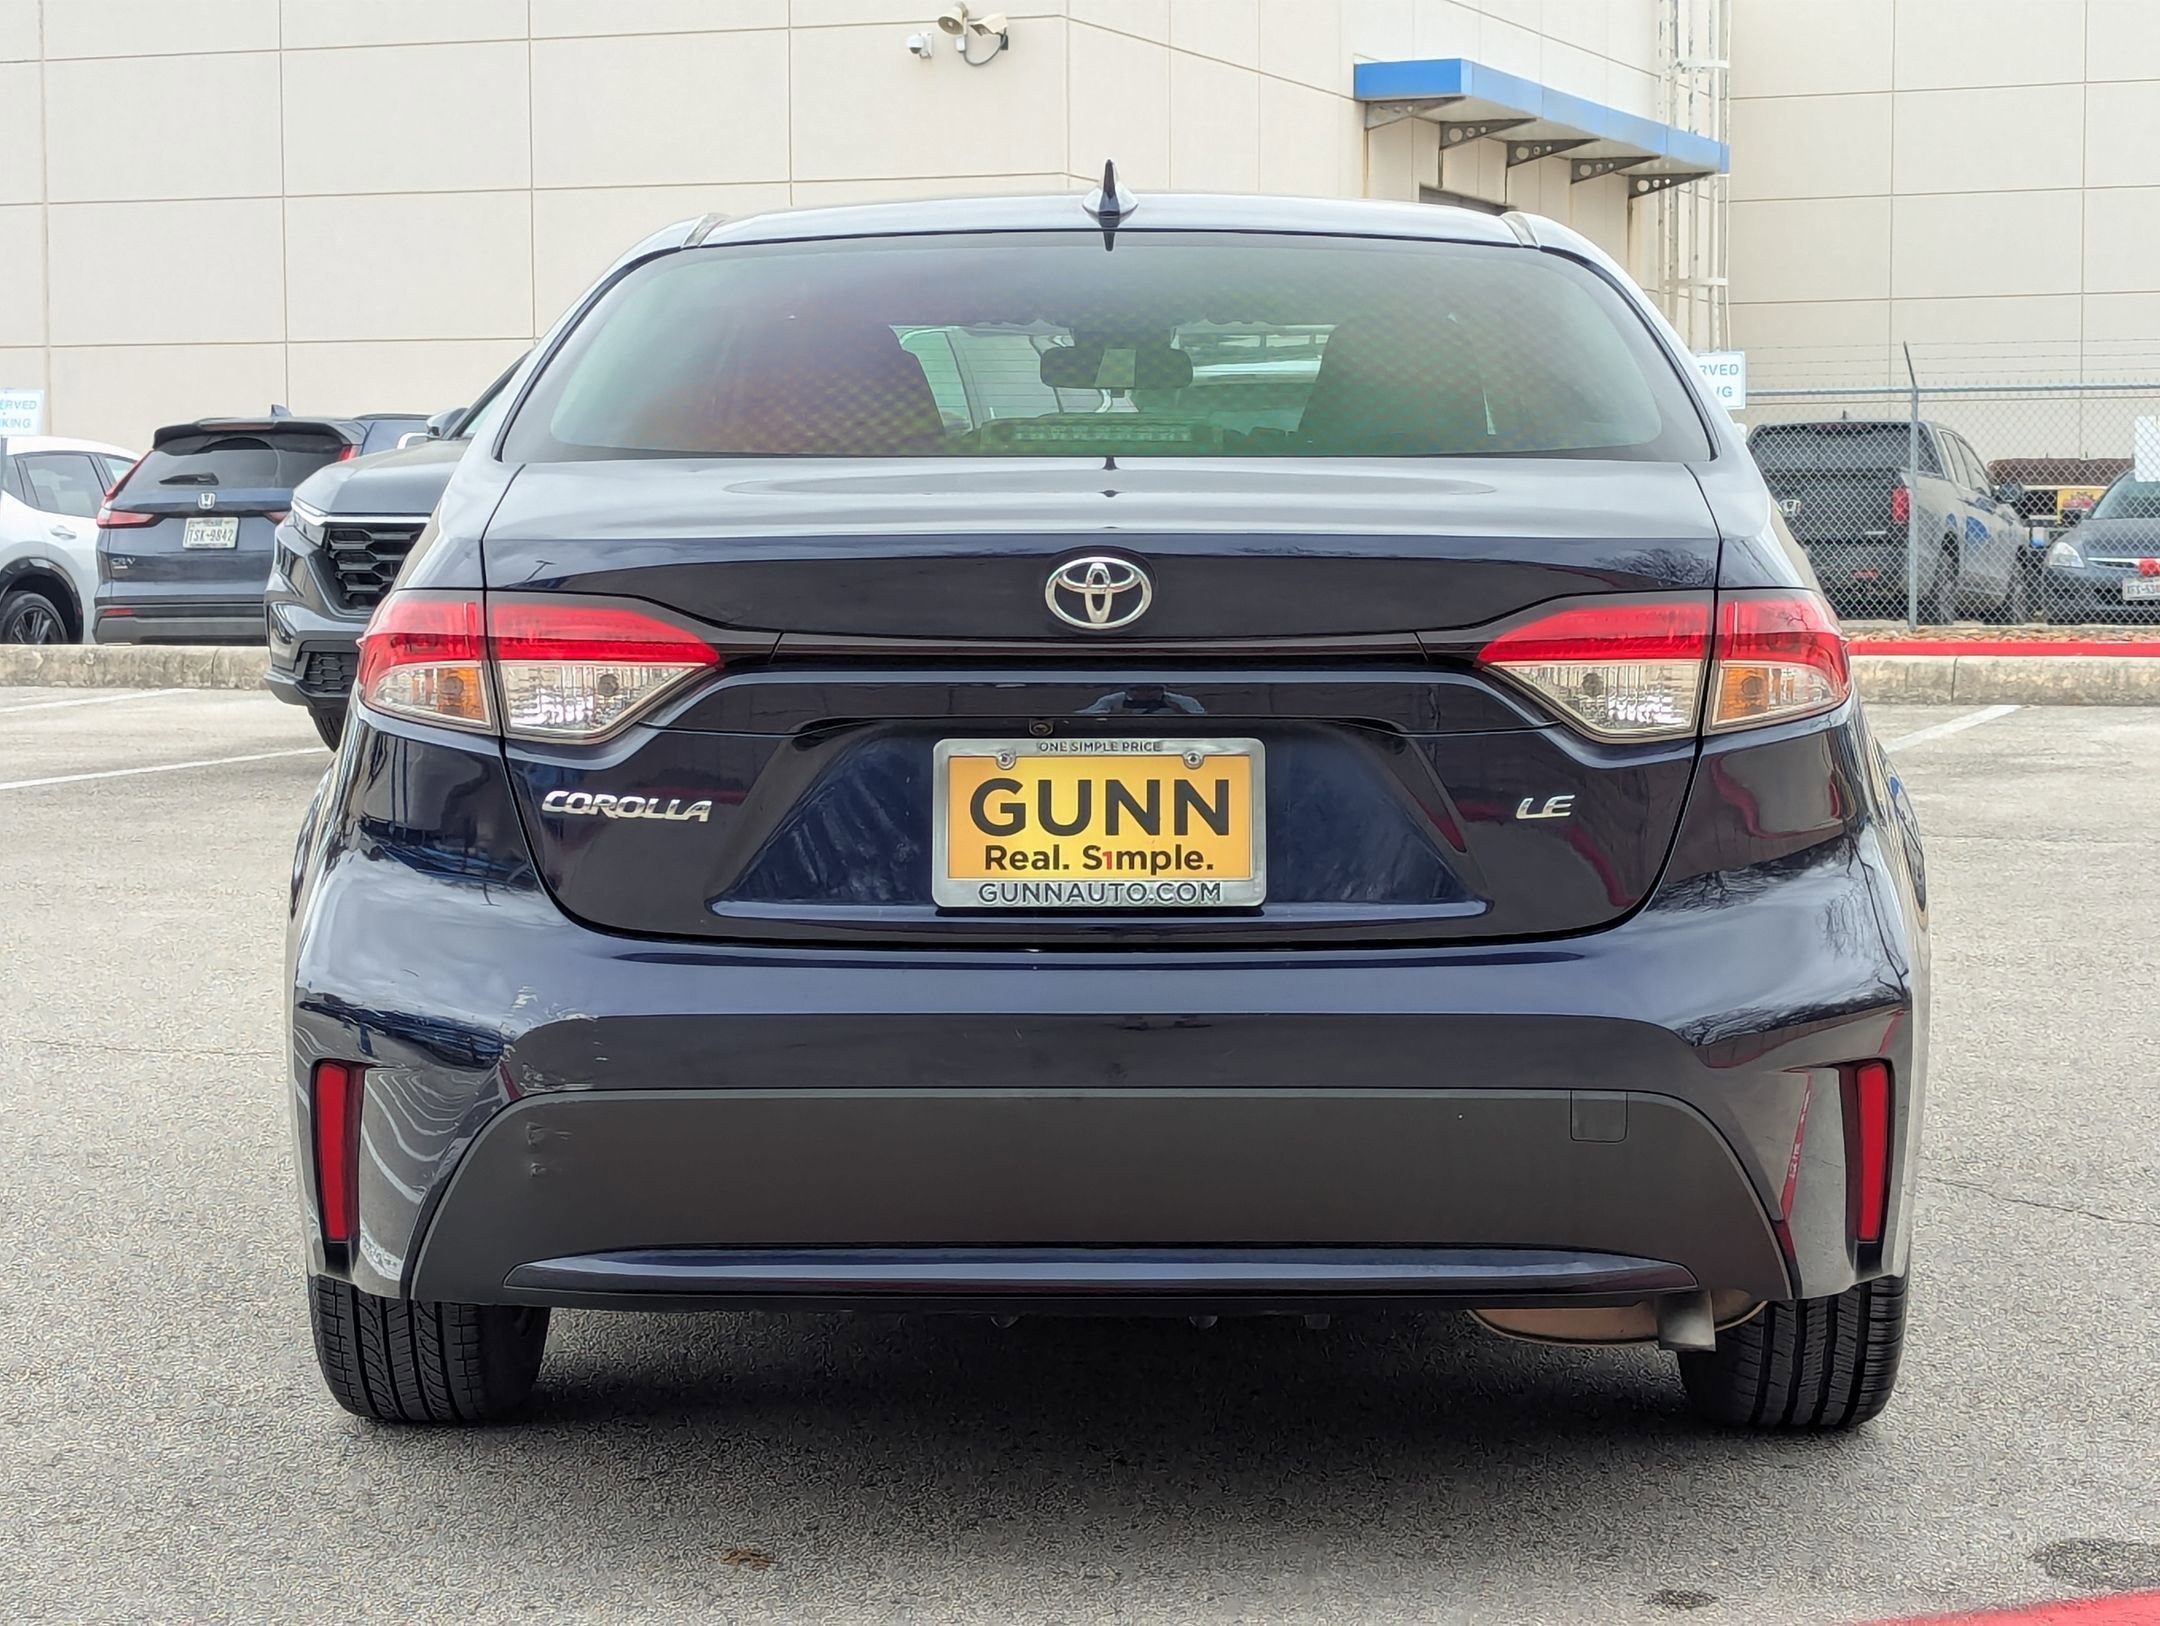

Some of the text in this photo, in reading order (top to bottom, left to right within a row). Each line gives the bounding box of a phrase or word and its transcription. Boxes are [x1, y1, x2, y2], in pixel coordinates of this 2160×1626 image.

[1039, 741, 1161, 752] ONE SIMPLE PRICE
[542, 790, 713, 823] COROLLA
[970, 778, 1230, 836] GUNN
[1515, 794, 1576, 820] LE
[985, 845, 1070, 871] Real.
[978, 882, 1221, 902] GUNNAUTO.COM
